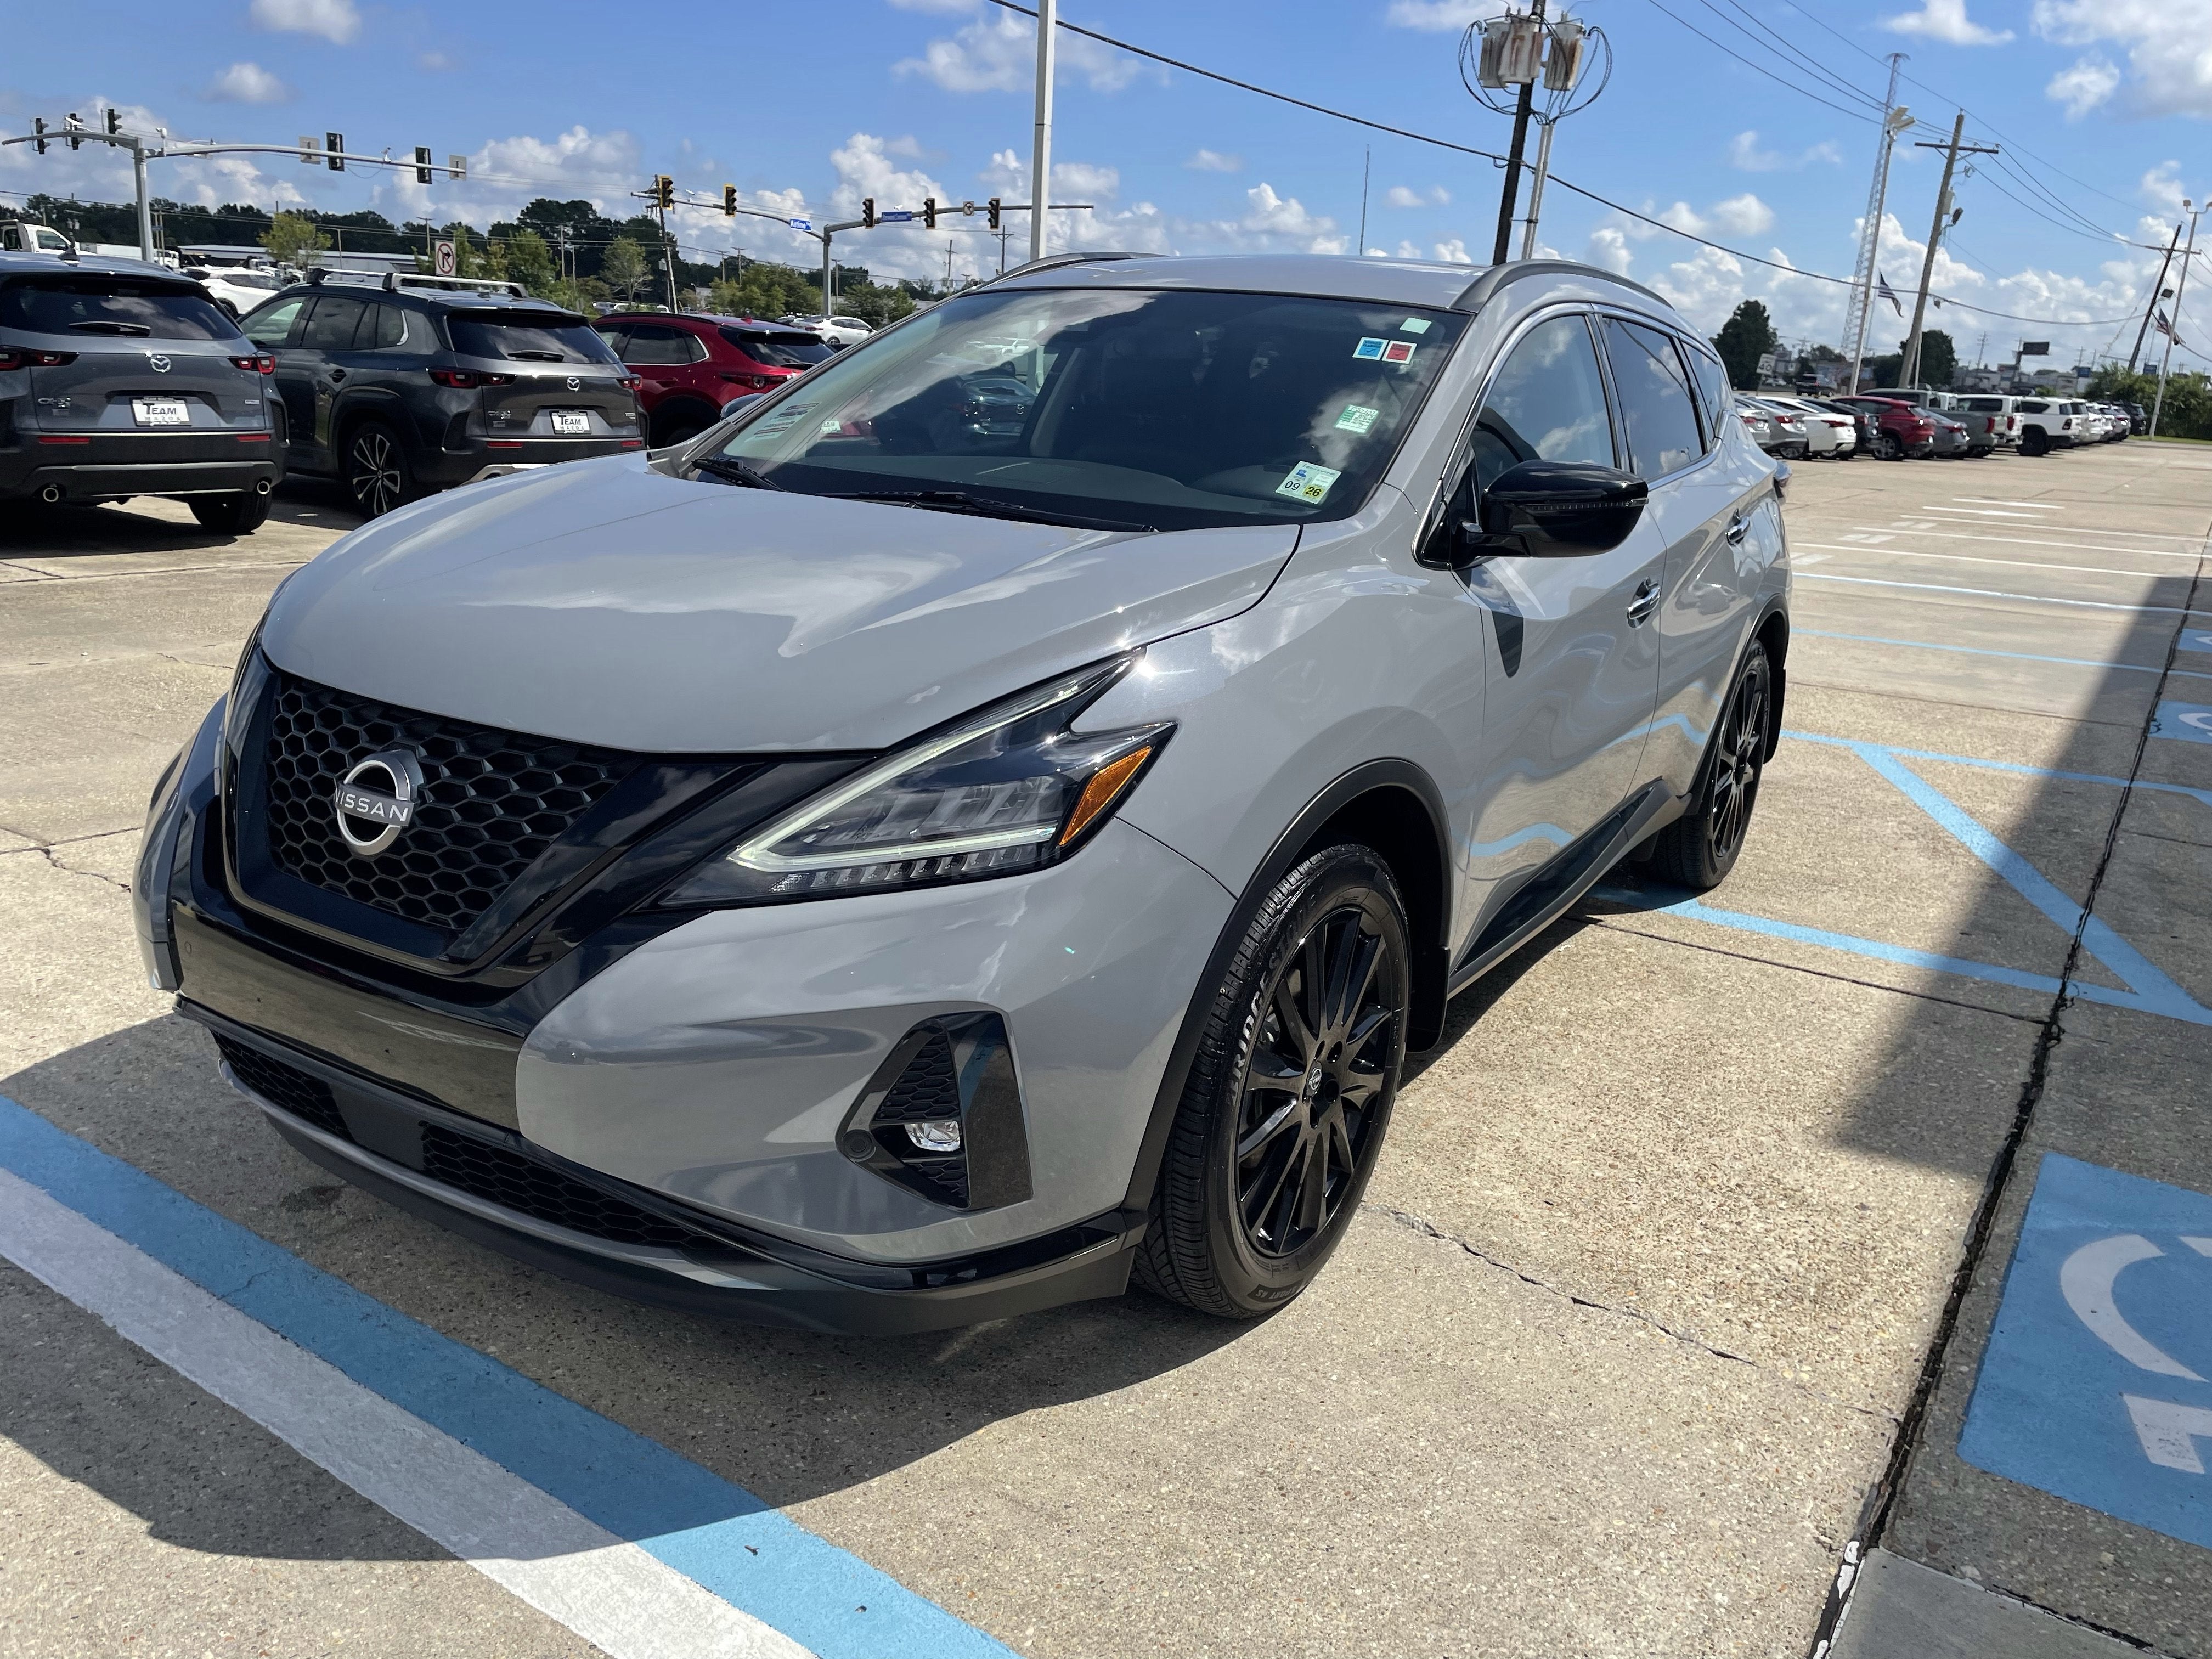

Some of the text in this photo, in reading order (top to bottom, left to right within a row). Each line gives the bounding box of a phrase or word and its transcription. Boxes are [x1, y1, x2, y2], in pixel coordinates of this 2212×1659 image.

[1284, 481, 1300, 490] 09
[1305, 487, 1322, 496] 26
[333, 787, 409, 822] NISSAN
